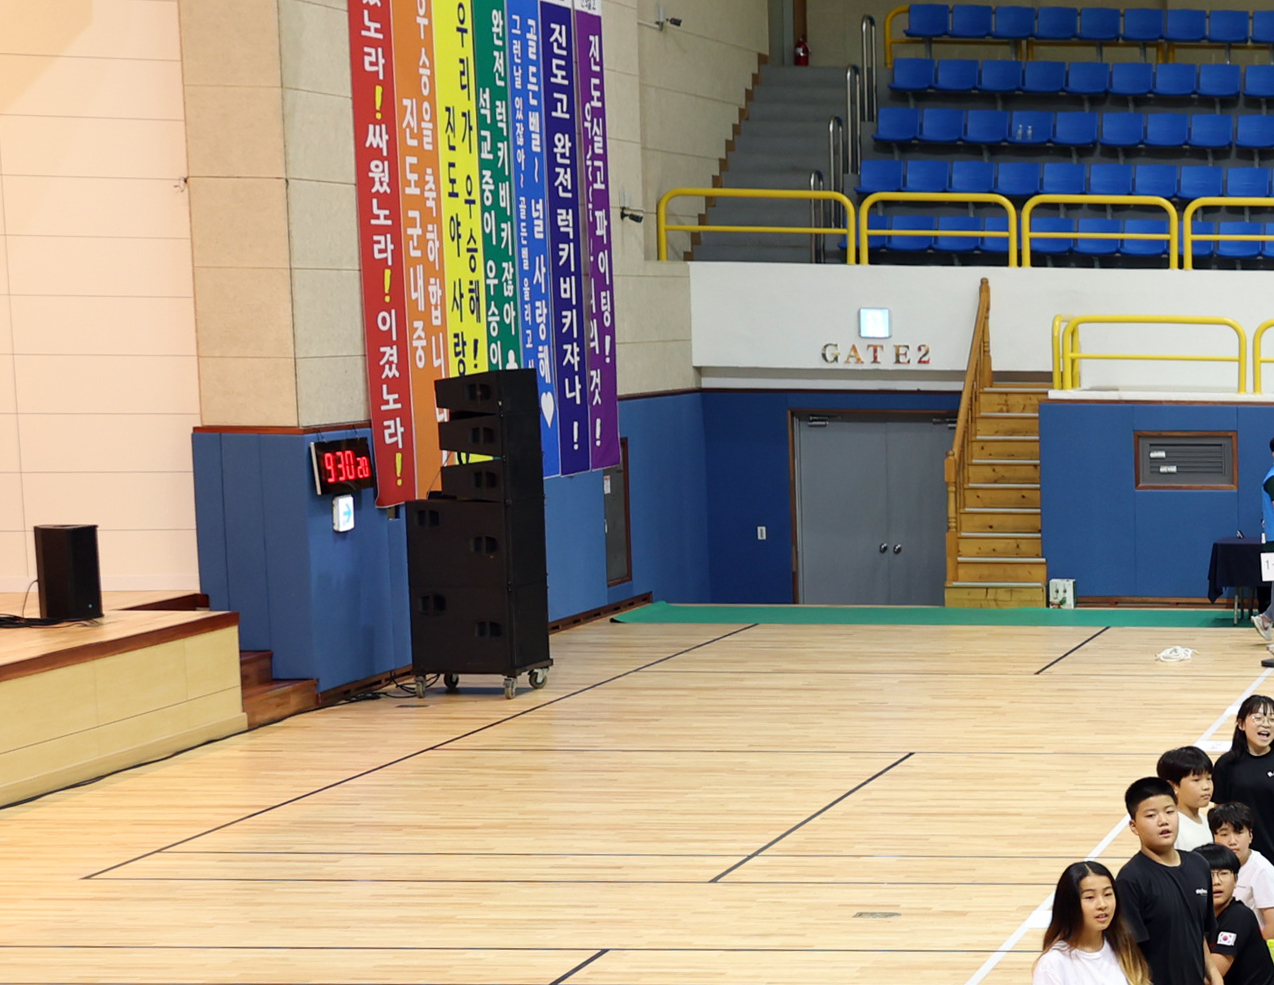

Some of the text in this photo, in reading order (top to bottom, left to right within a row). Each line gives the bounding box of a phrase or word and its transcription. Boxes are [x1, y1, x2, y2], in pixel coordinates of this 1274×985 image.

[361, 0, 386, 120] 노라!
[416, 0, 433, 150] 우승을
[491, 9, 505, 87] 완전
[549, 23, 571, 119] 진도고
[588, 35, 606, 190] 진도실고
[456, 2, 481, 369] 우리가 우승해!
[479, 88, 497, 246] 석교중이
[531, 198, 545, 239] 널
[553, 133, 573, 198] 완전
[445, 106, 467, 377] 진도야 사랑
[594, 209, 612, 364] 파이팅!
